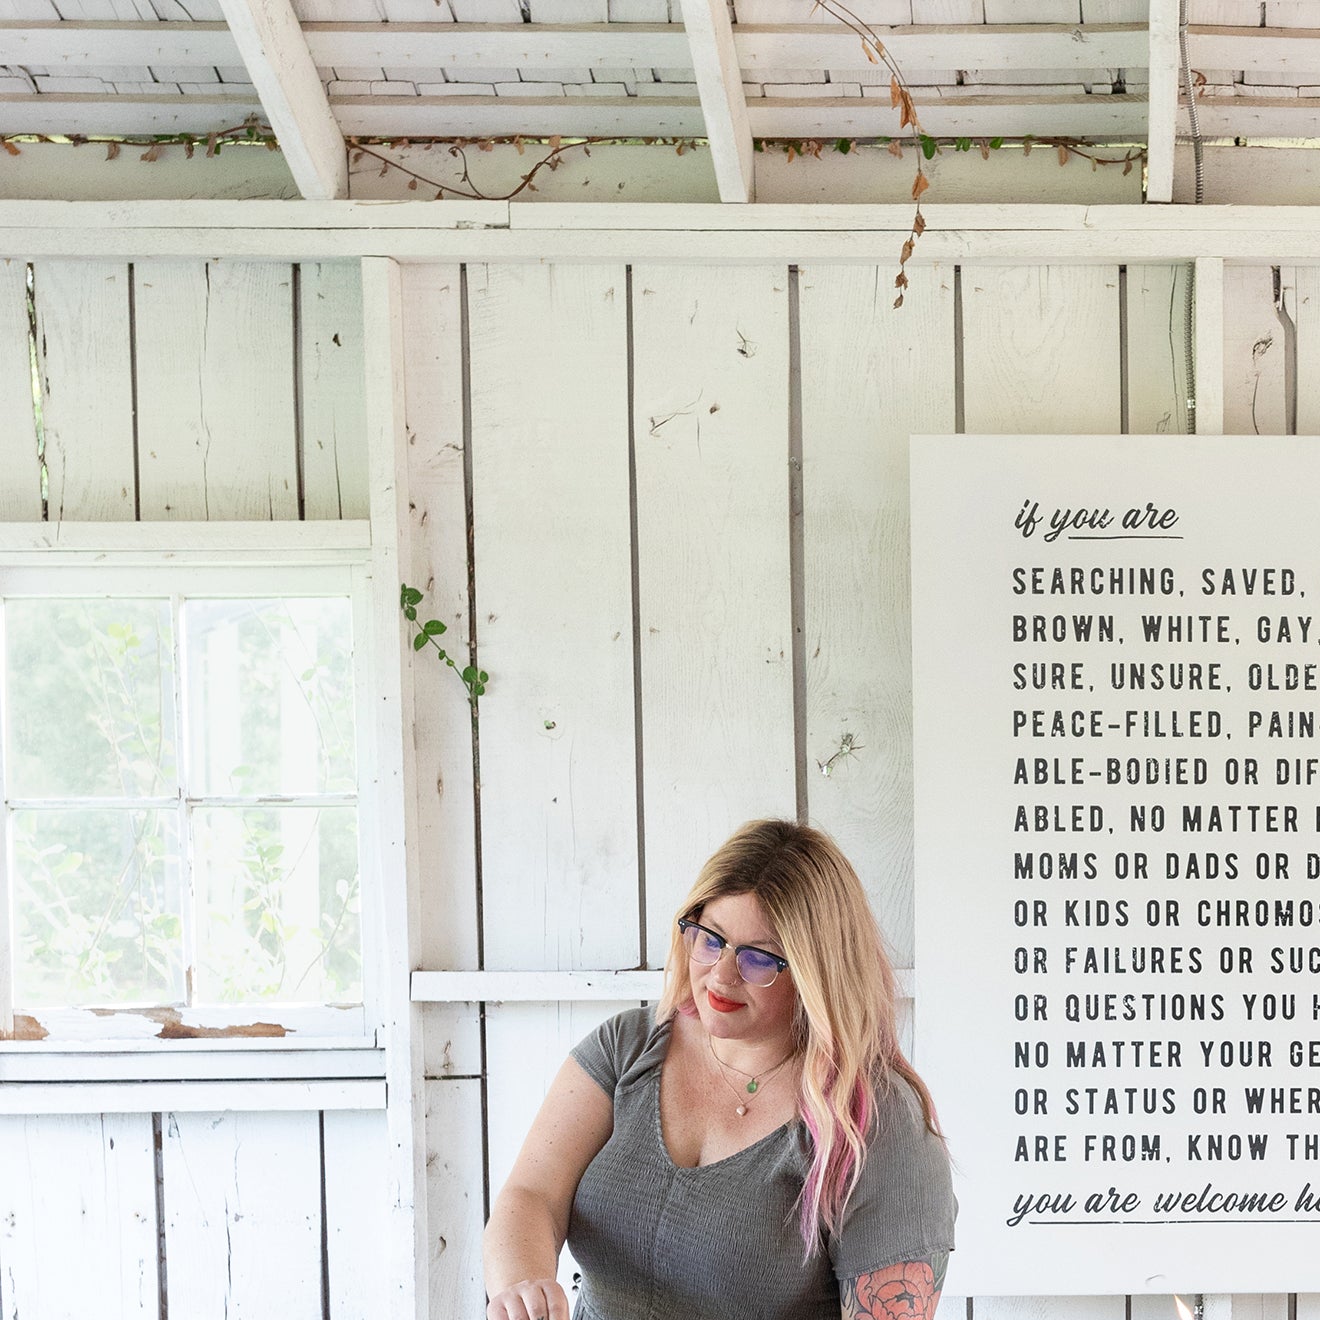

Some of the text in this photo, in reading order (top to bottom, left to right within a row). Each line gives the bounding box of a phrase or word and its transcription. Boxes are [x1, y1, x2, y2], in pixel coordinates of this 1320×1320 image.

[1014, 499, 1180, 543] if you are
[1012, 567, 1184, 598] SEARCHING,
[1201, 568, 1305, 598] SAVED,
[1012, 614, 1124, 645] BROWN,
[1141, 615, 1240, 646] WHITE,
[1013, 662, 1094, 693] SURE,
[1111, 662, 1231, 693] UNSURE,
[1013, 710, 1231, 740] PEACE-FILLED,
[1013, 757, 1208, 785] ABLE-BODIED
[1225, 758, 1259, 786] OR
[1014, 805, 1114, 835] ABLED,
[1130, 805, 1165, 833] NO
[1182, 805, 1298, 833] MATTER
[1014, 852, 1098, 880] MOMS
[1115, 852, 1148, 880] OR
[1166, 852, 1239, 880] DADS
[1256, 852, 1290, 880] OR
[1014, 899, 1048, 927] OR
[1065, 899, 1129, 927] KIDS
[1146, 899, 1180, 927] OR
[1014, 947, 1048, 975] OR
[1065, 946, 1203, 974] FAILURES
[1219, 946, 1253, 974] OR
[1014, 994, 1048, 1022] OR
[1065, 993, 1225, 1023] QUESTIONS
[1242, 993, 1296, 1021] YOU
[1014, 1041, 1049, 1069] NO
[1066, 1040, 1182, 1068] MATTER
[1199, 1040, 1272, 1068] YOUR
[1014, 1088, 1048, 1115] OR
[1065, 1087, 1176, 1115] STATUS
[1193, 1087, 1227, 1115] OR
[1014, 1135, 1067, 1162] ARE
[1084, 1134, 1171, 1163] FROM,
[1188, 1134, 1268, 1161] KNOW
[1005, 1193, 1078, 1227] you
[1083, 1186, 1142, 1214] are
[1153, 1182, 1289, 1214] welcome
